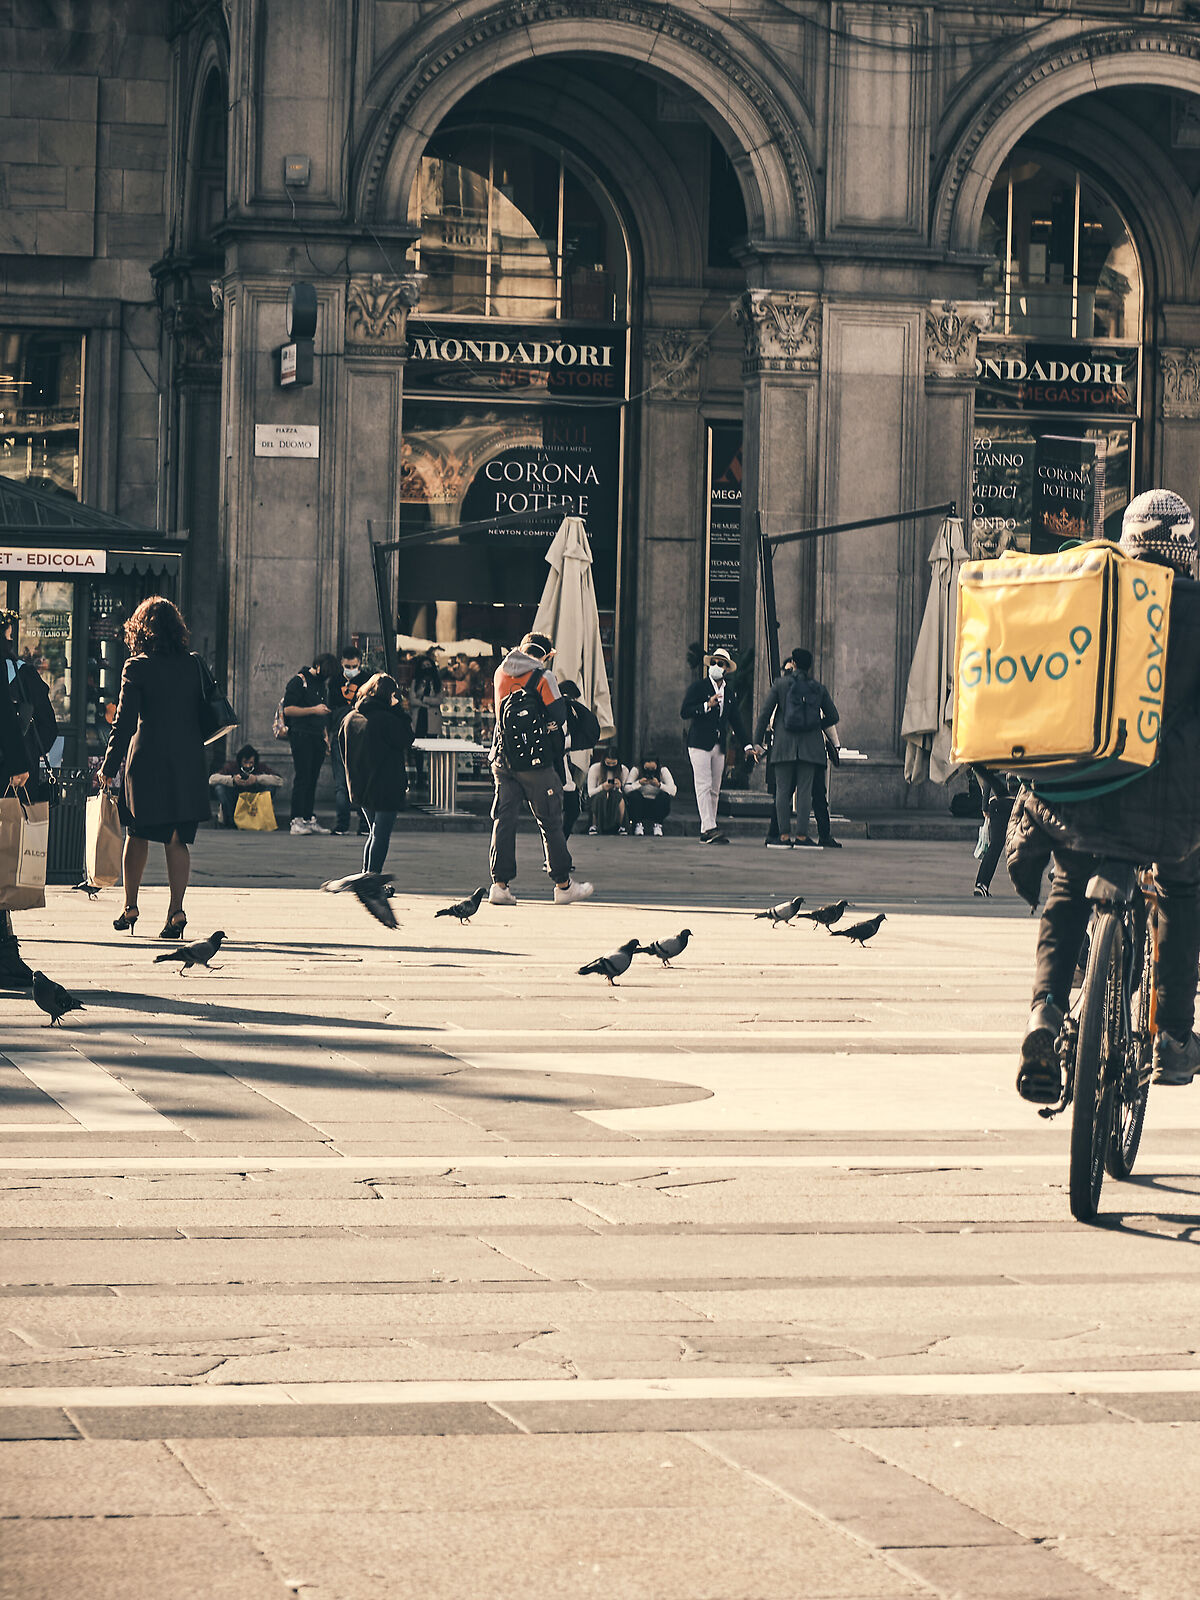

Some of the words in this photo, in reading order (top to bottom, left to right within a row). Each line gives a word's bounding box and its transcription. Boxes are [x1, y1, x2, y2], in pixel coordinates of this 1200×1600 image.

[410, 338, 615, 367] MONDADORI
[500, 368, 615, 388] MEGASTORE
[1018, 386, 1127, 405] MEGASTORE
[279, 440, 312, 449] DUOMO
[485, 461, 600, 485] CORONA
[1037, 465, 1091, 485] CORONA
[1043, 483, 1086, 501] POTERE
[26, 554, 96, 567] EDICOLA
[960, 648, 1069, 688] Glovo
[1137, 604, 1164, 743] Glovo
